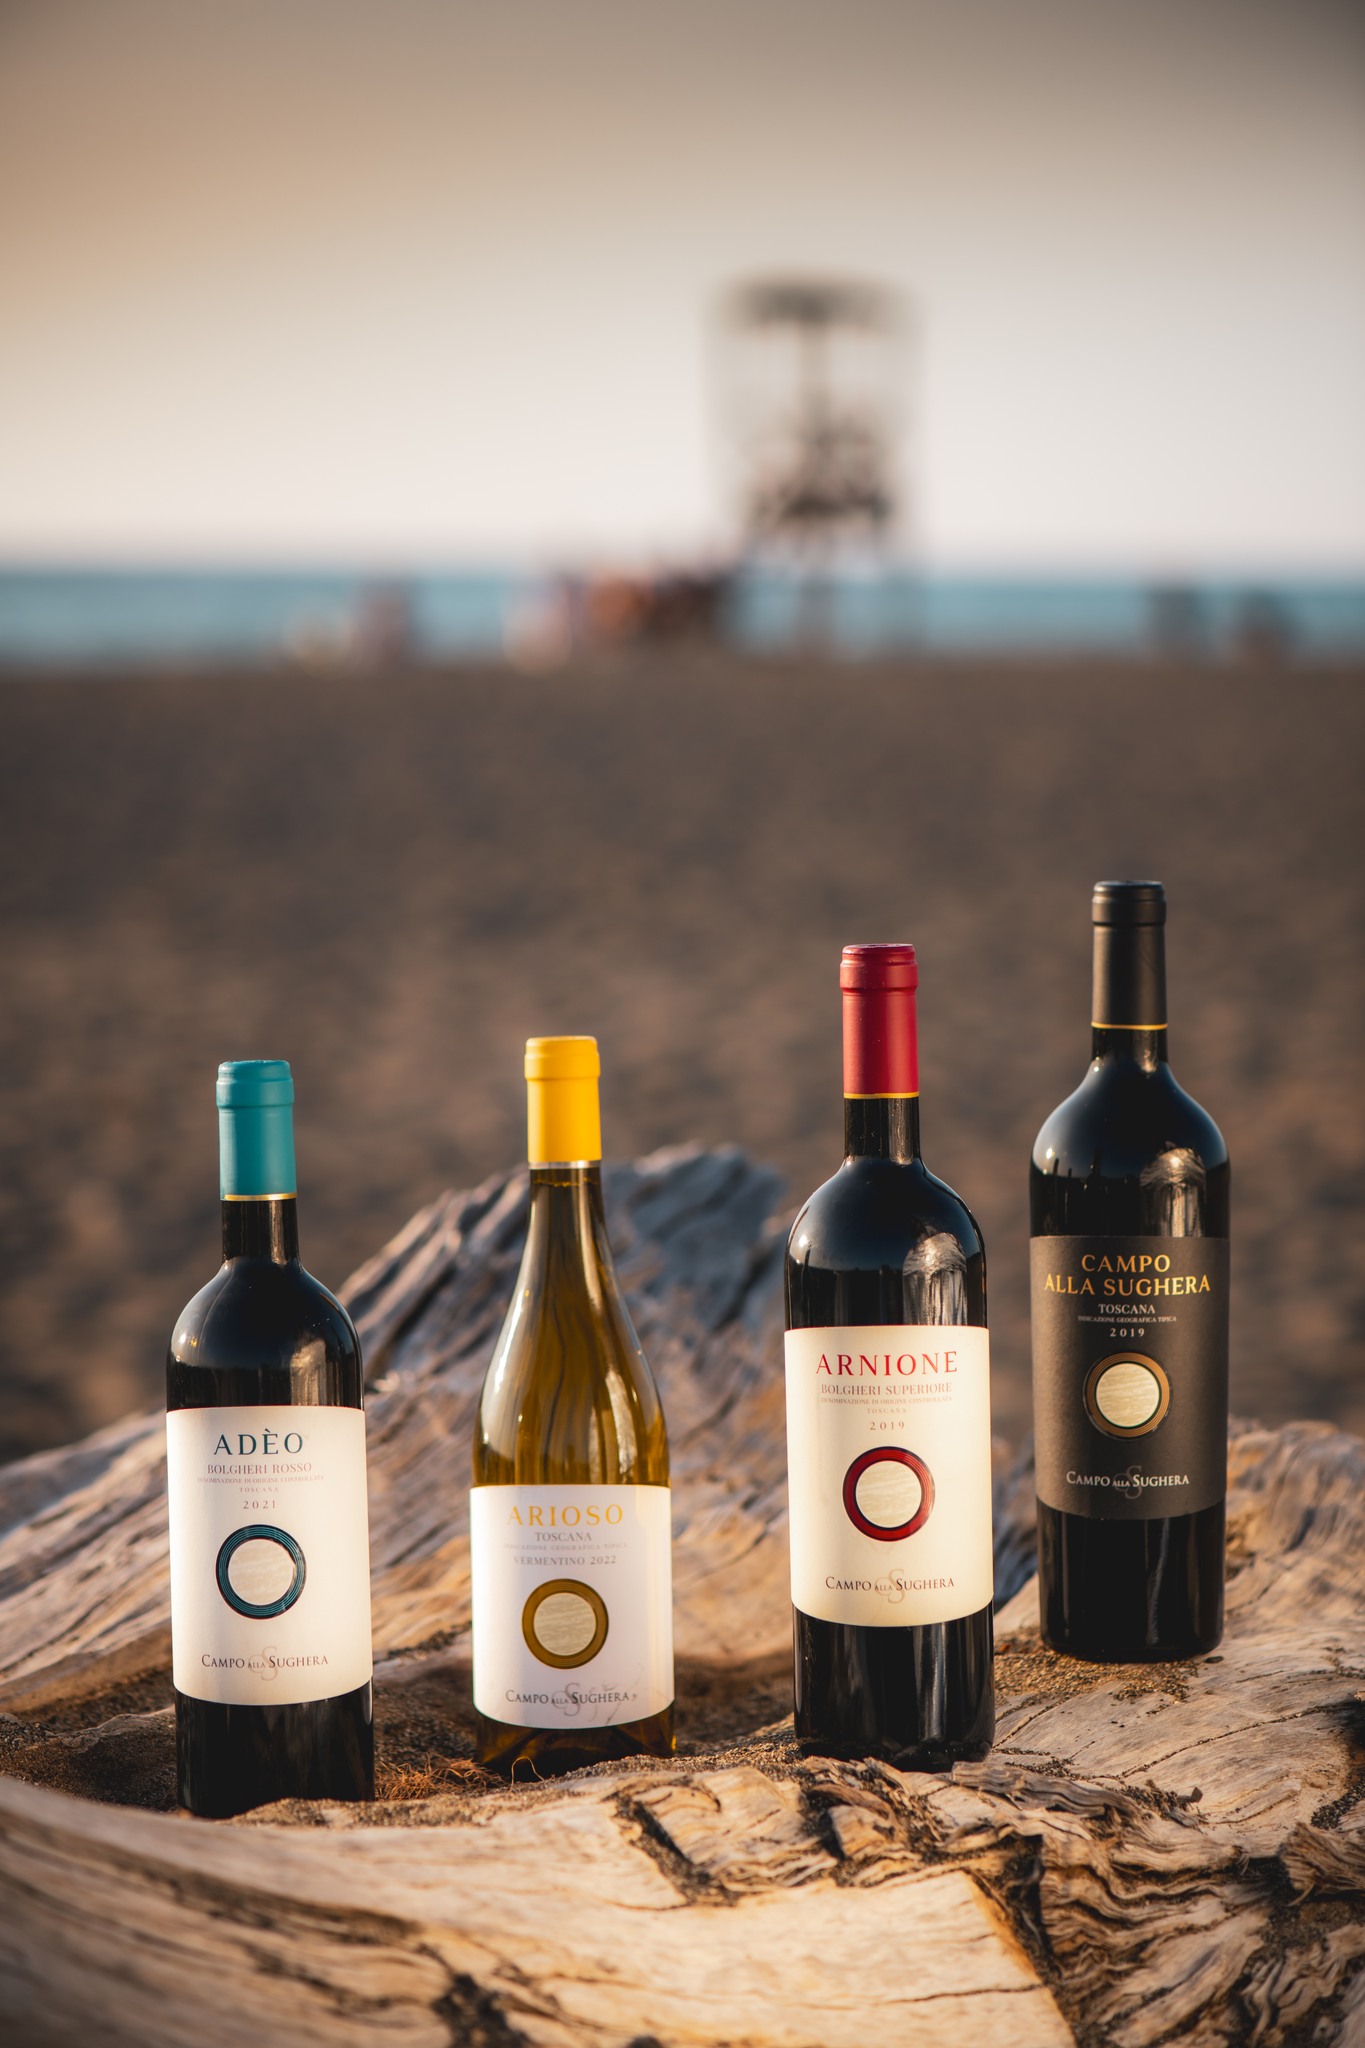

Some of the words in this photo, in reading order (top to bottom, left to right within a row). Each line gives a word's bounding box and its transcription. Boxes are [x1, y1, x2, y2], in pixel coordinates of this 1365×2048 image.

[1081, 1254, 1171, 1273] CAMPO
[1044, 1273, 1096, 1296] ALLA
[1103, 1274, 1211, 1296] SUGHERA
[1098, 1304, 1156, 1314] TOSCANA
[1109, 1328, 1145, 1337] 2019
[815, 1351, 958, 1376] ARNIONE
[821, 1384, 881, 1395] BOLGHERI
[885, 1382, 952, 1395] SUPERIORE
[869, 1421, 905, 1430] 2019
[213, 1428, 303, 1455] ADÈO
[207, 1464, 267, 1475] BOLGHERI
[272, 1462, 312, 1474] ROSSO
[243, 1500, 276, 1509] 2021
[506, 1503, 623, 1526] ARIOSO
[535, 1532, 592, 1542] TOSCANA
[513, 1555, 585, 1566] VERMENTINO
[590, 1555, 617, 1565] 2022
